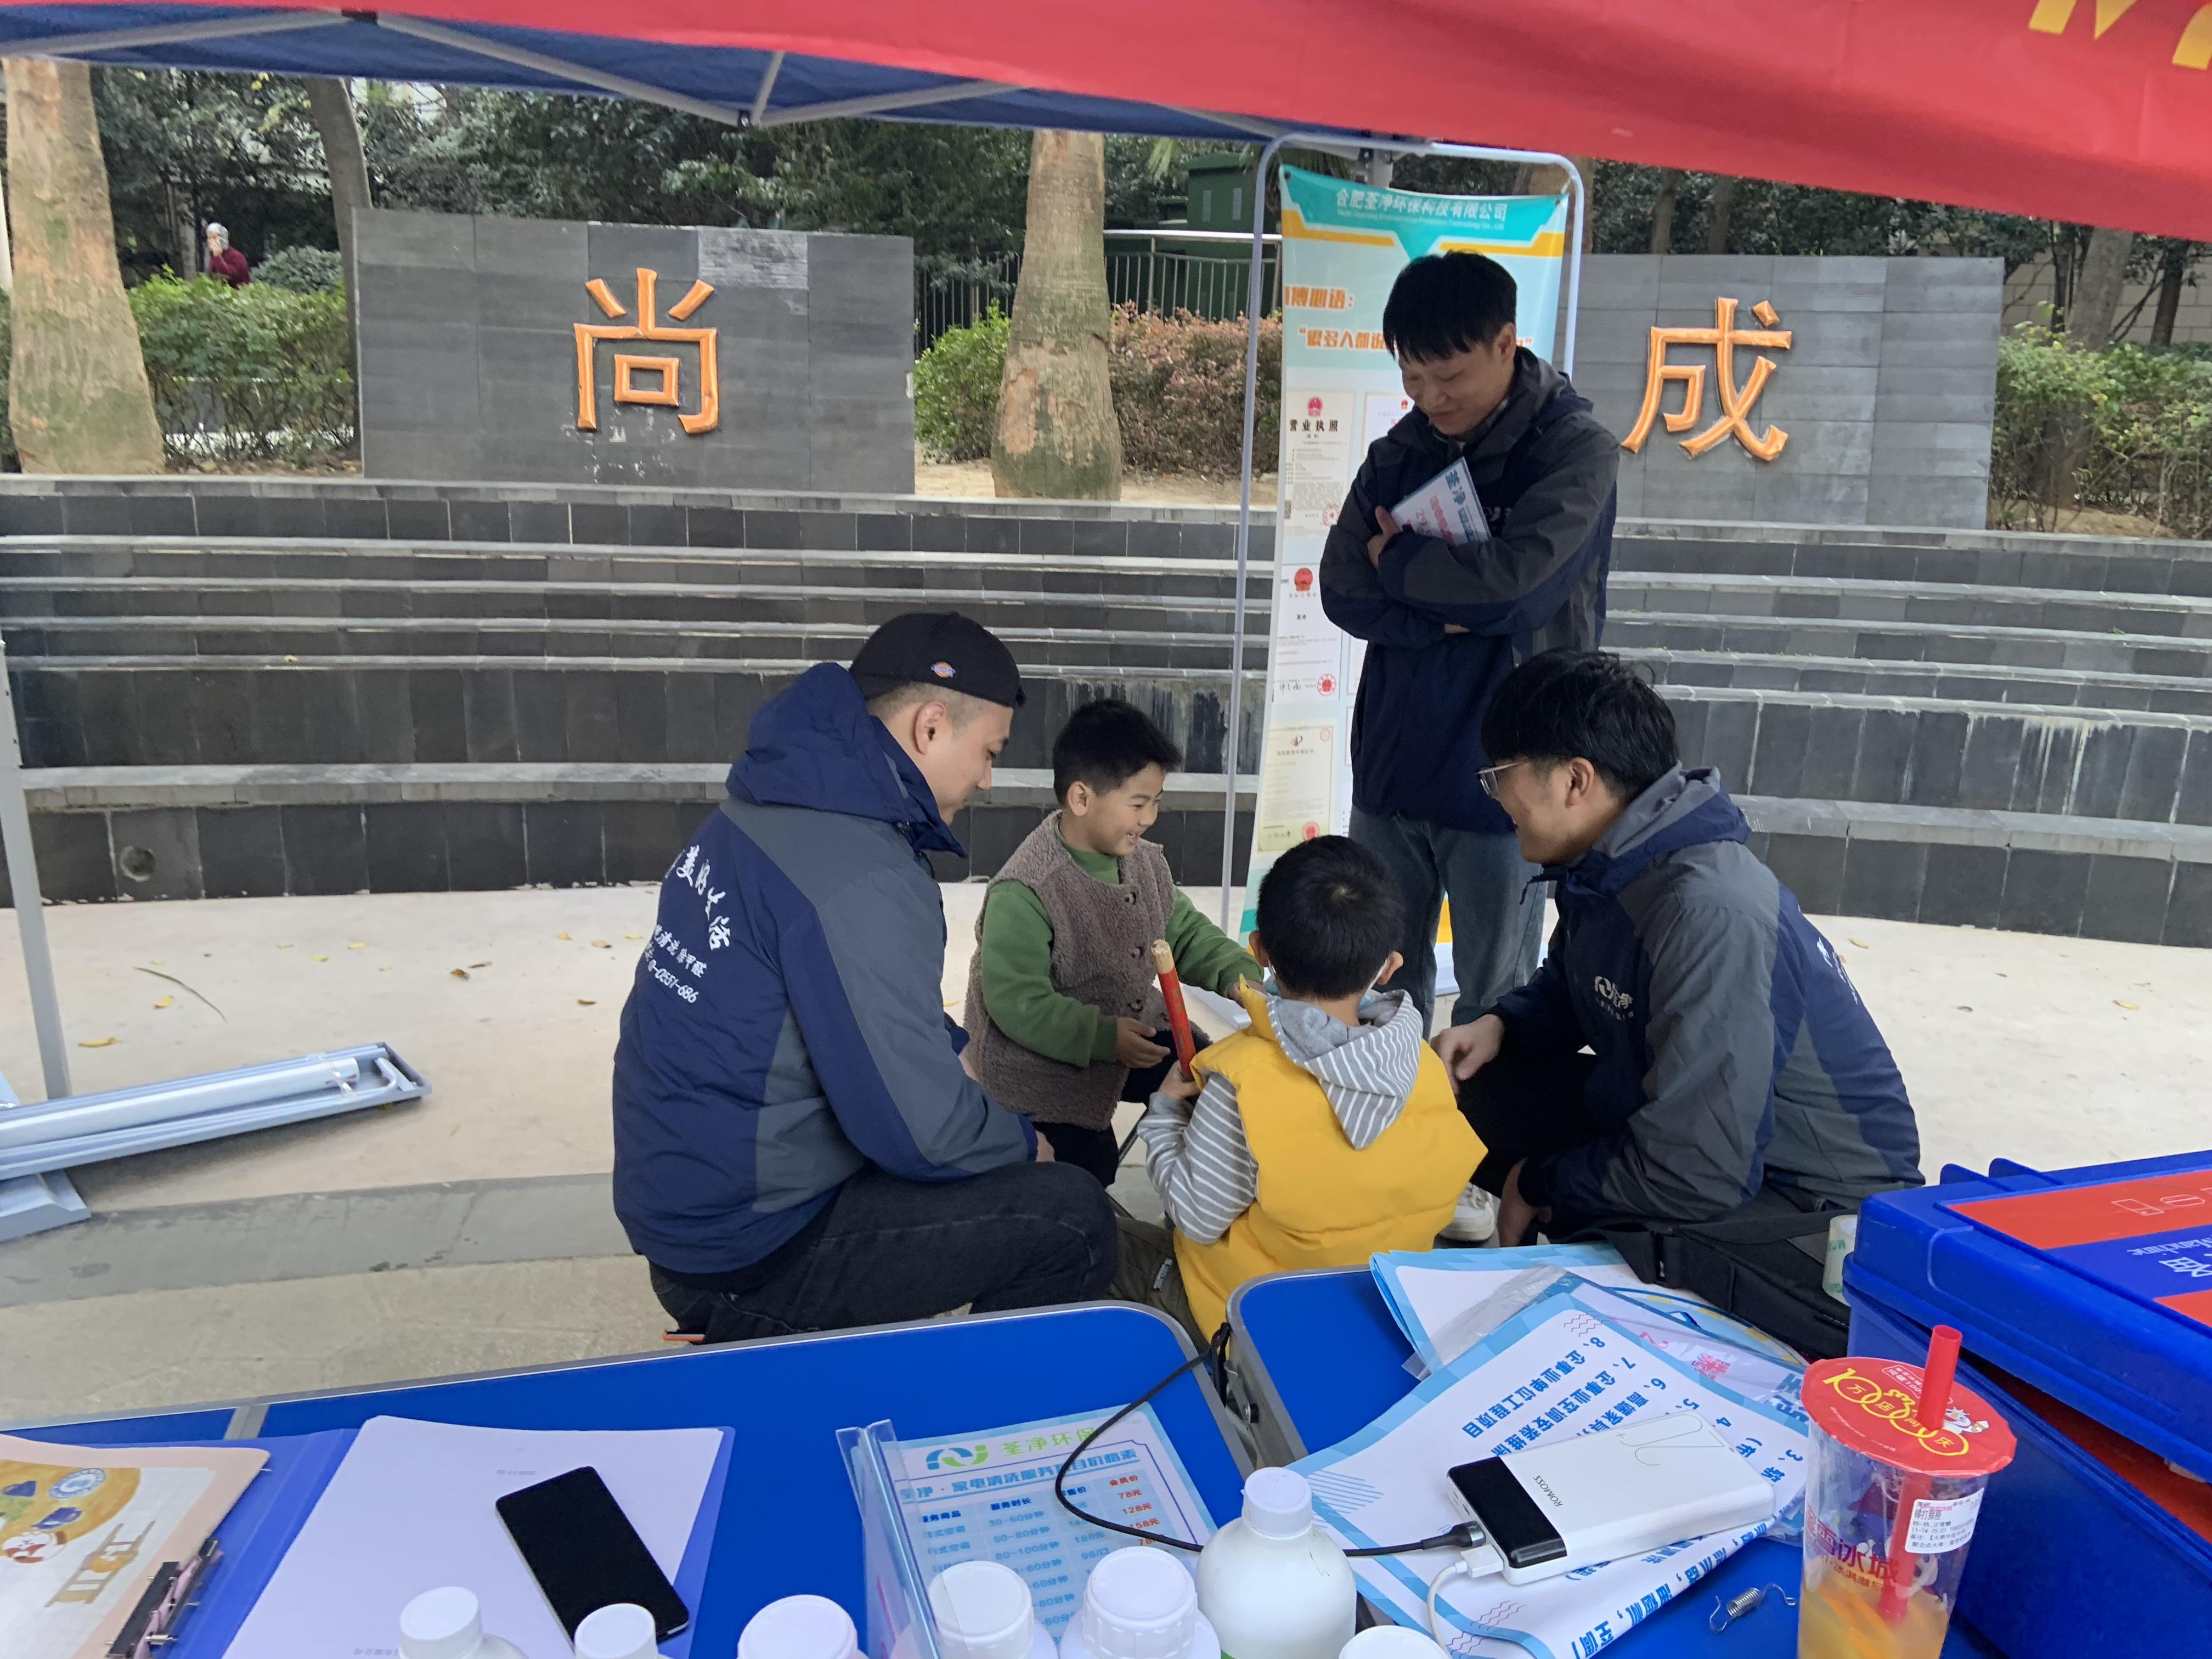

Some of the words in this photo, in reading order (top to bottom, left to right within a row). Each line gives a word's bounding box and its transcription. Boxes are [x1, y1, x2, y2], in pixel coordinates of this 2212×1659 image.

[573, 267, 719, 433] 尚
[1621, 297, 1792, 462] 成
[1290, 419, 1339, 432] 营业执照
[1462, 1336, 1606, 1438] 8、企事业单位工程项目
[1000, 1427, 1096, 1457] 荃净环保
[989, 1510, 1045, 1527] 30-60分钟
[1118, 1488, 1143, 1499] 78元
[990, 1497, 1032, 1511] 服务时长
[1109, 1474, 1139, 1487] 会员价
[1122, 1502, 1153, 1515] 128元
[1533, 1475, 1564, 1507] ROMOSS
[996, 1541, 1059, 1560] 80-100分钟
[1129, 1517, 1160, 1530] 158元
